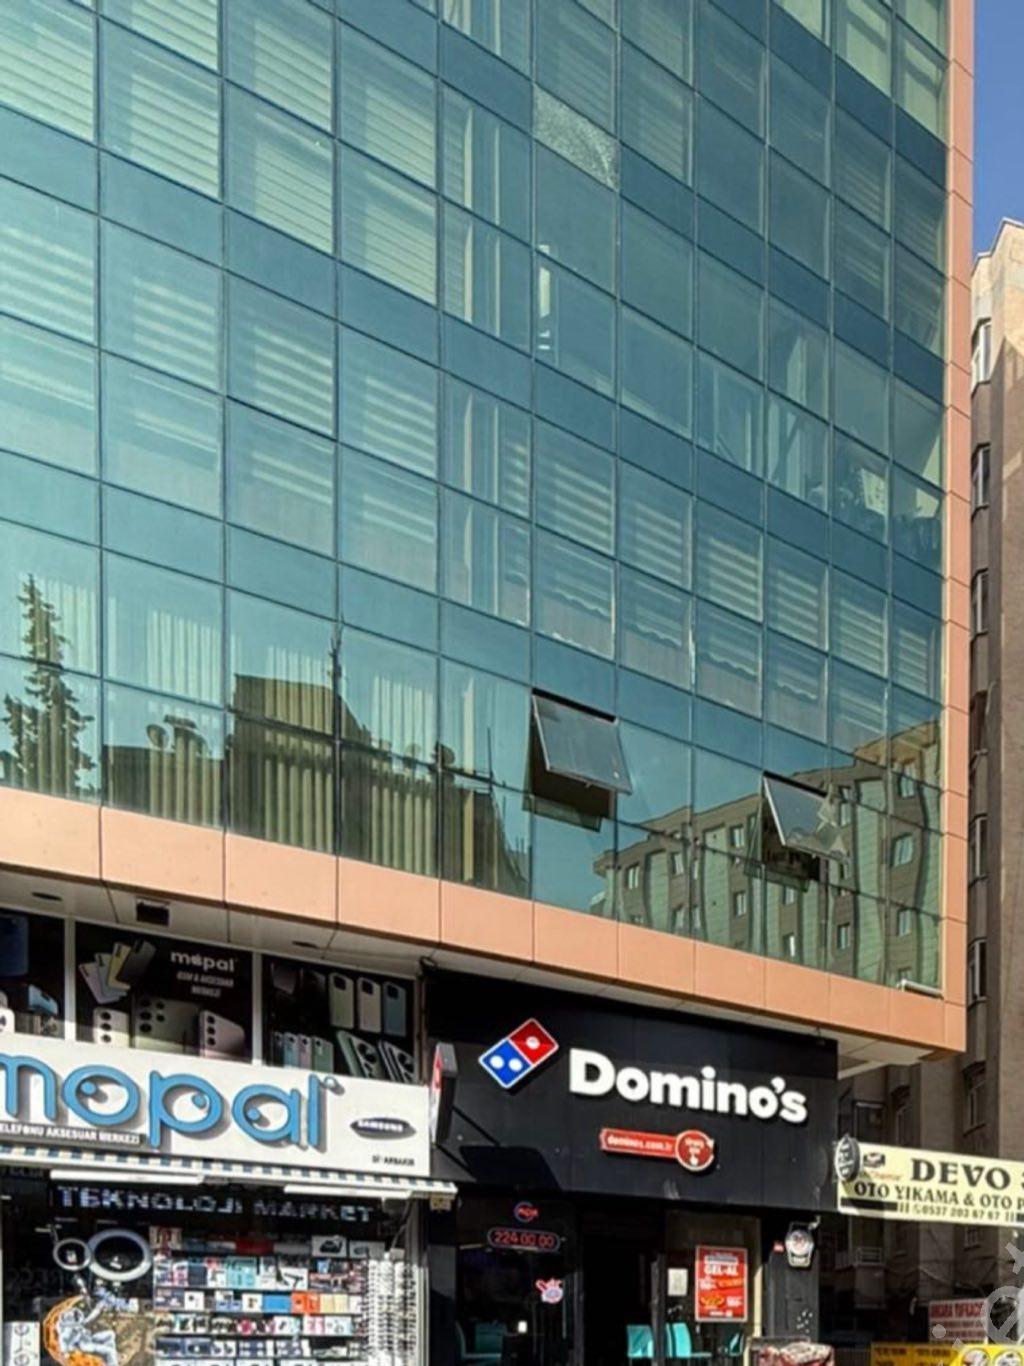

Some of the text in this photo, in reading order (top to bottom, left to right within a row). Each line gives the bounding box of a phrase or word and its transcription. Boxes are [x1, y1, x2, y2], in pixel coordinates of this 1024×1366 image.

[569, 1048, 808, 1123] Domino's
[911, 1158, 1011, 1191] DEVO
[254, 1198, 373, 1223] MARKET
[854, 1181, 890, 1198] OTO
[895, 1185, 959, 1206] YIKAMA
[980, 1194, 1012, 1210] OTO
